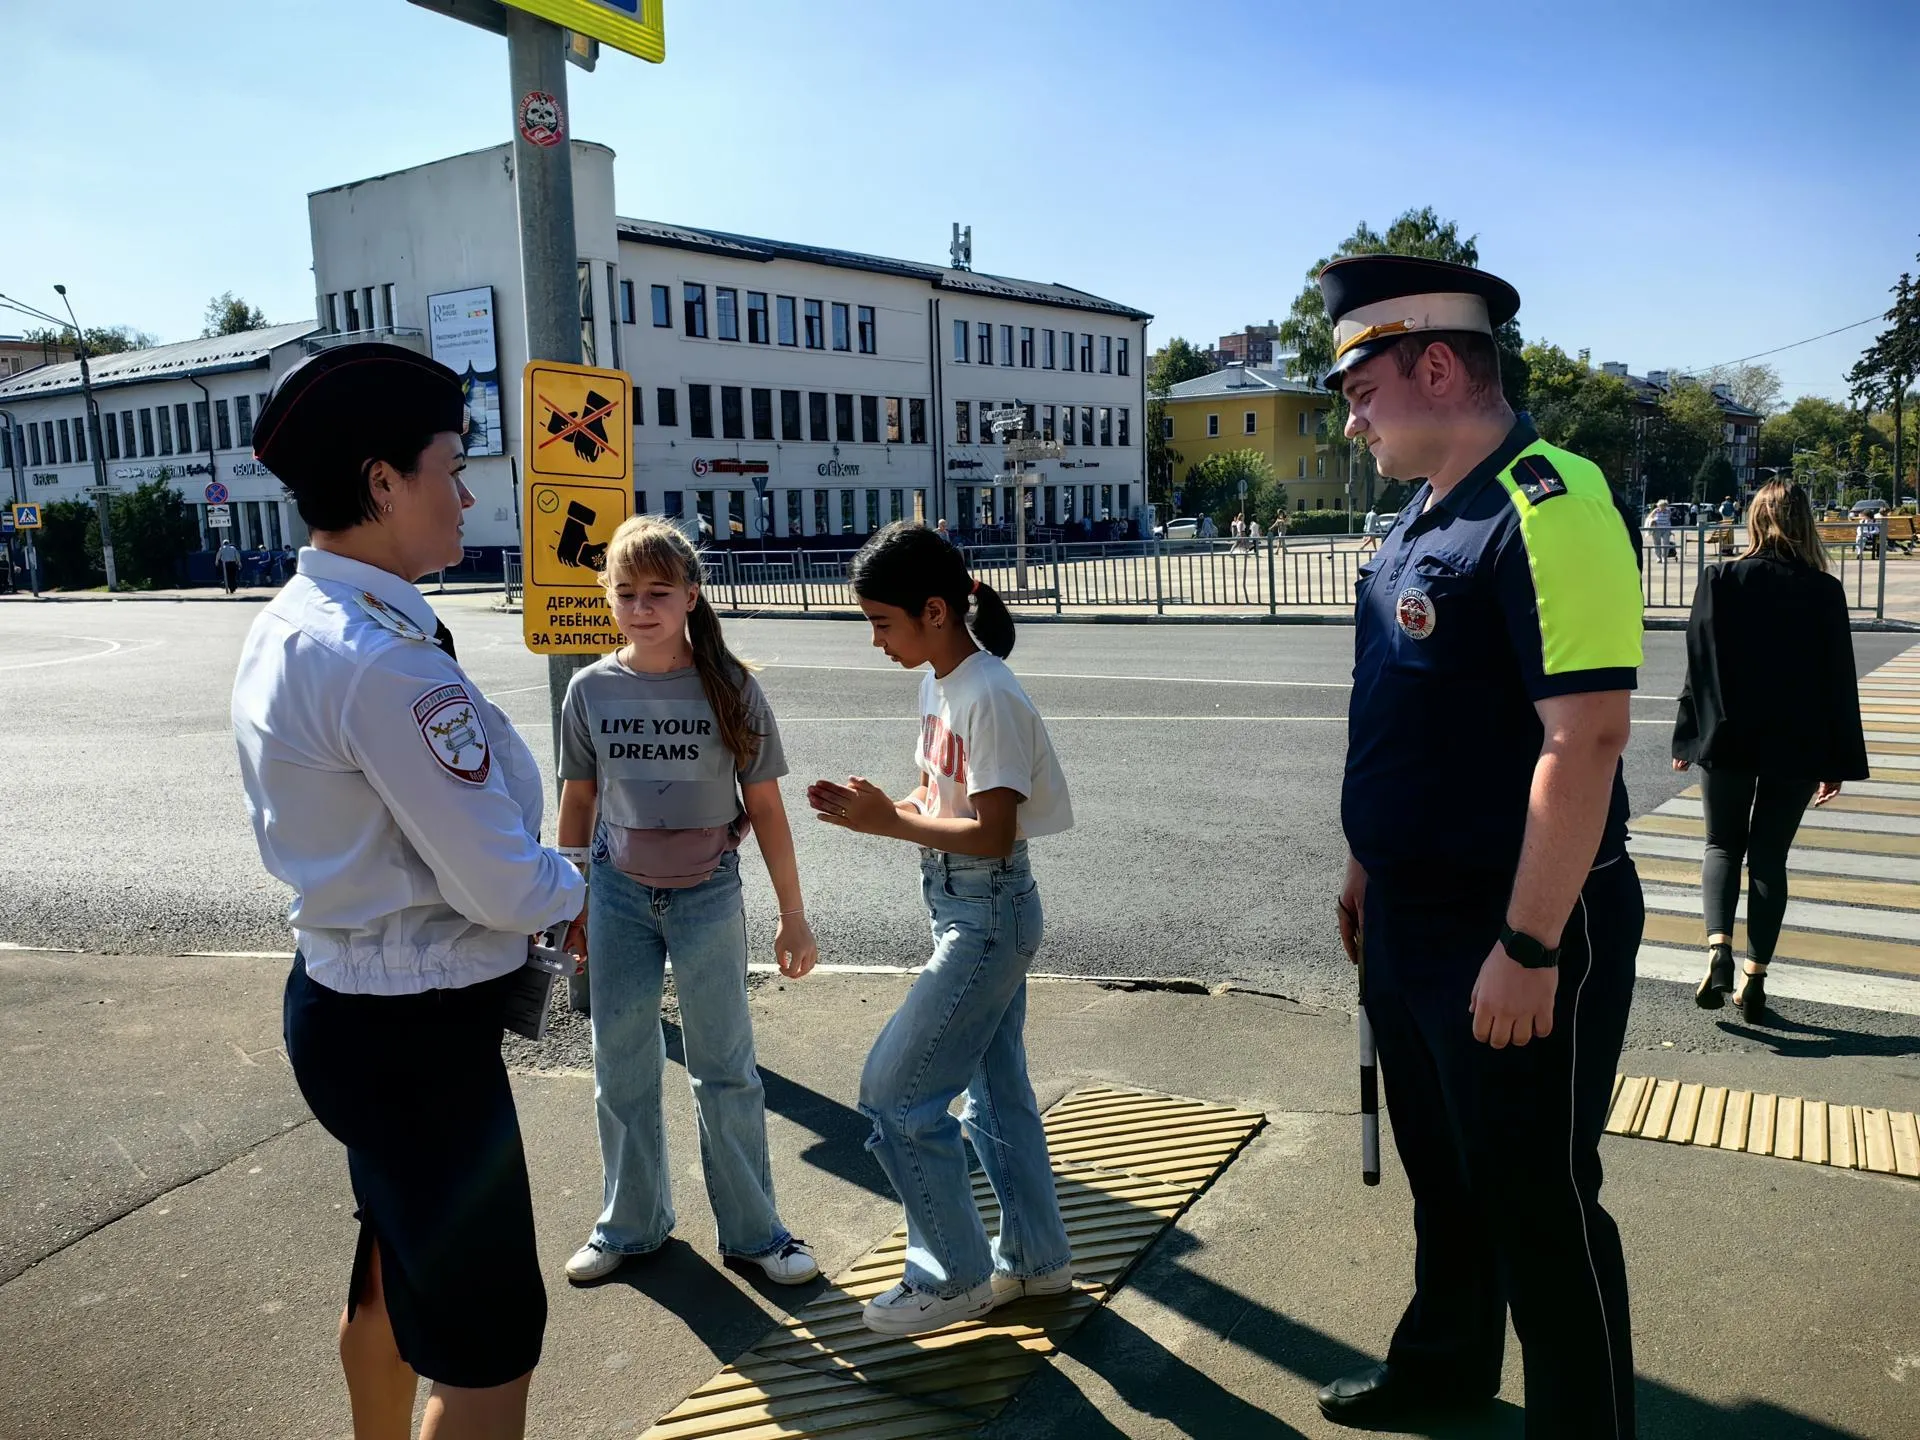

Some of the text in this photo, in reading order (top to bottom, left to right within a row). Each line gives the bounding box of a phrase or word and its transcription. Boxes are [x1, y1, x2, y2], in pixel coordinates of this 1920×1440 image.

[550, 612, 612, 627] РЕБЁНКА
[532, 633, 628, 645] ЗА ЗАПЯСТЬЕ!
[417, 686, 464, 716] ПОЛИЦИЯ
[600, 718, 712, 736] LIVE YOUR
[609, 742, 700, 761] DREAMS
[469, 764, 488, 782] МВД
